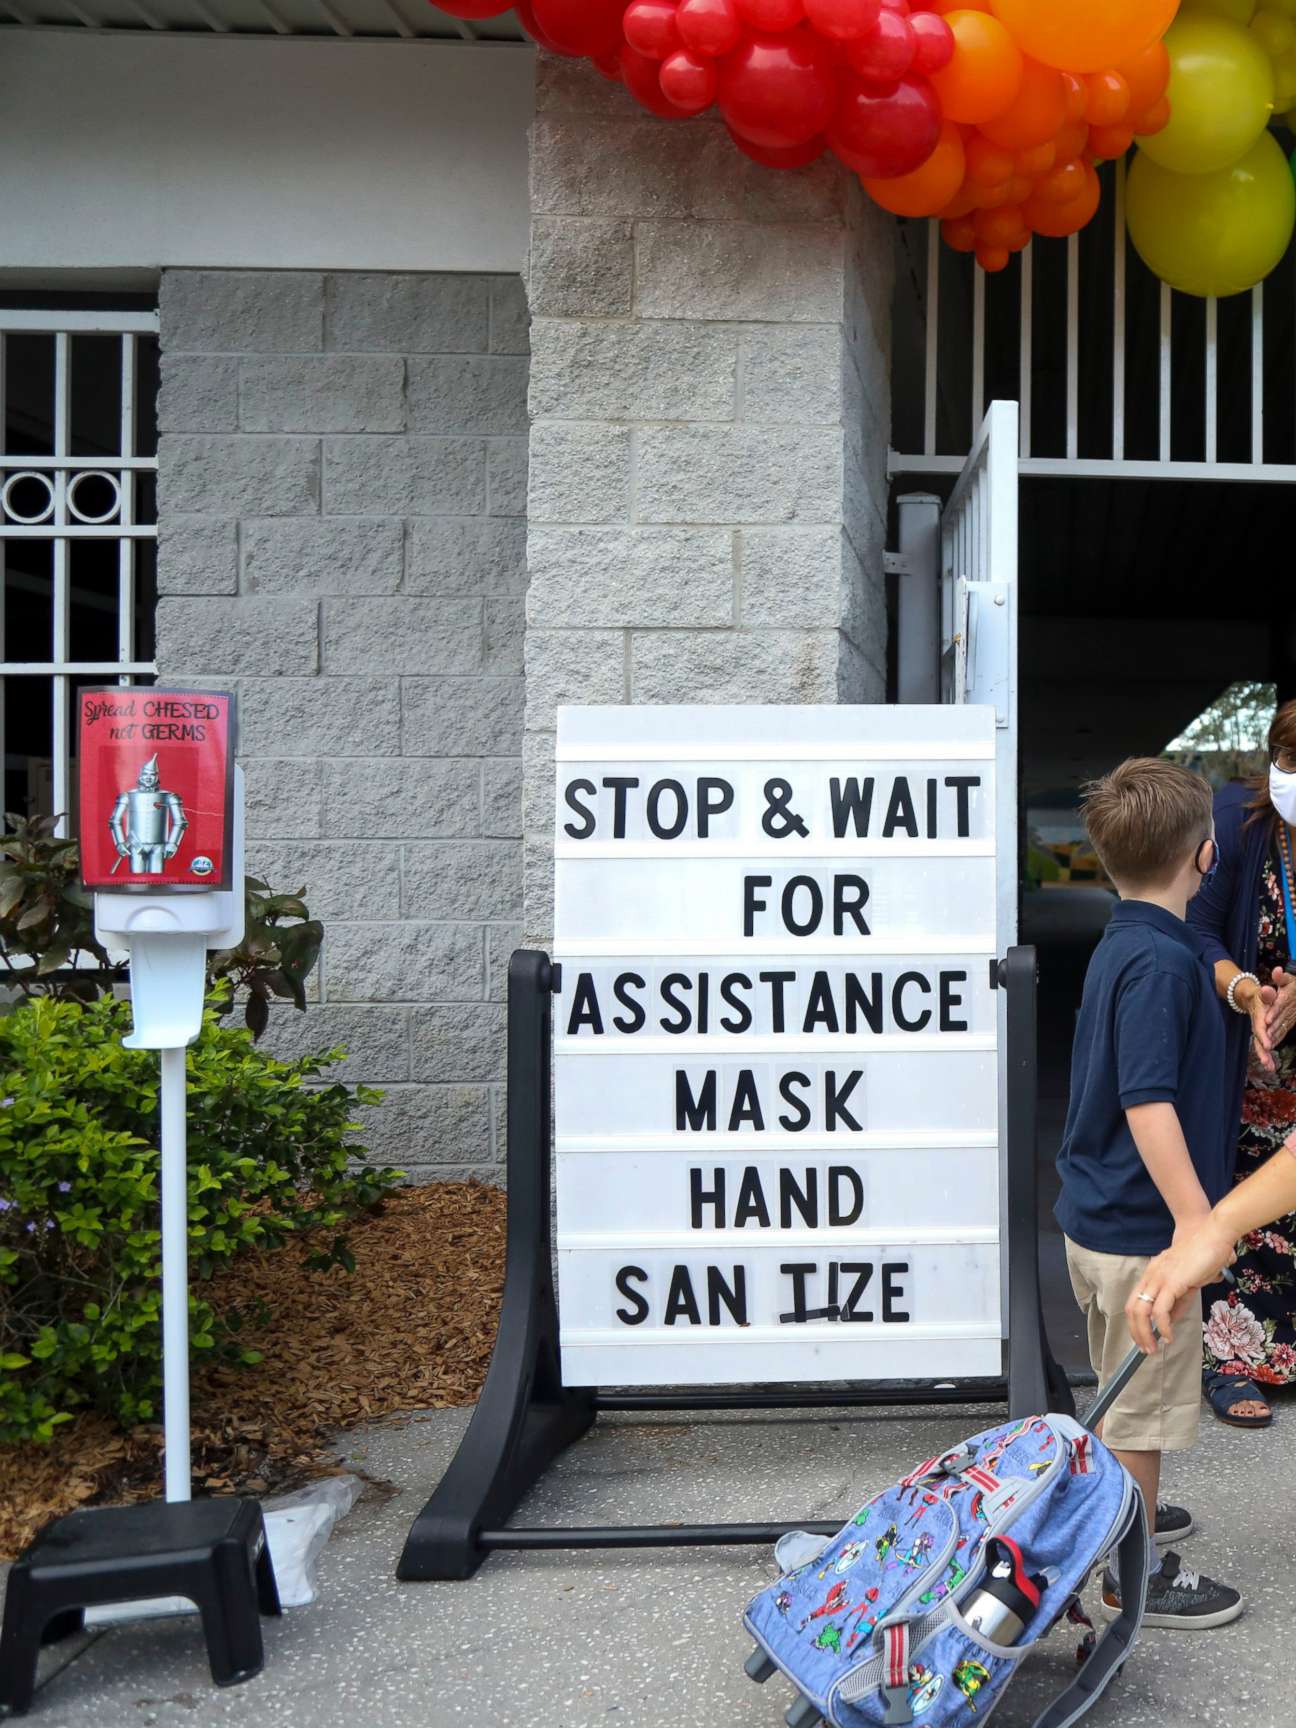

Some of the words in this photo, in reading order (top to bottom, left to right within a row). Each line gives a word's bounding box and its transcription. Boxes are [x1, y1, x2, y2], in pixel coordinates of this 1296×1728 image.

[84, 701, 136, 726] Spread
[143, 701, 219, 720] CHESED
[110, 724, 139, 739] not
[142, 723, 206, 741] GERMS
[563, 777, 734, 840] STOP
[761, 777, 810, 839] &
[829, 776, 981, 839] WAIT
[743, 875, 871, 937] FOR
[566, 971, 968, 1035] ASSISTANCE
[675, 1069, 864, 1132] MASK
[689, 1165, 864, 1229] HAND
